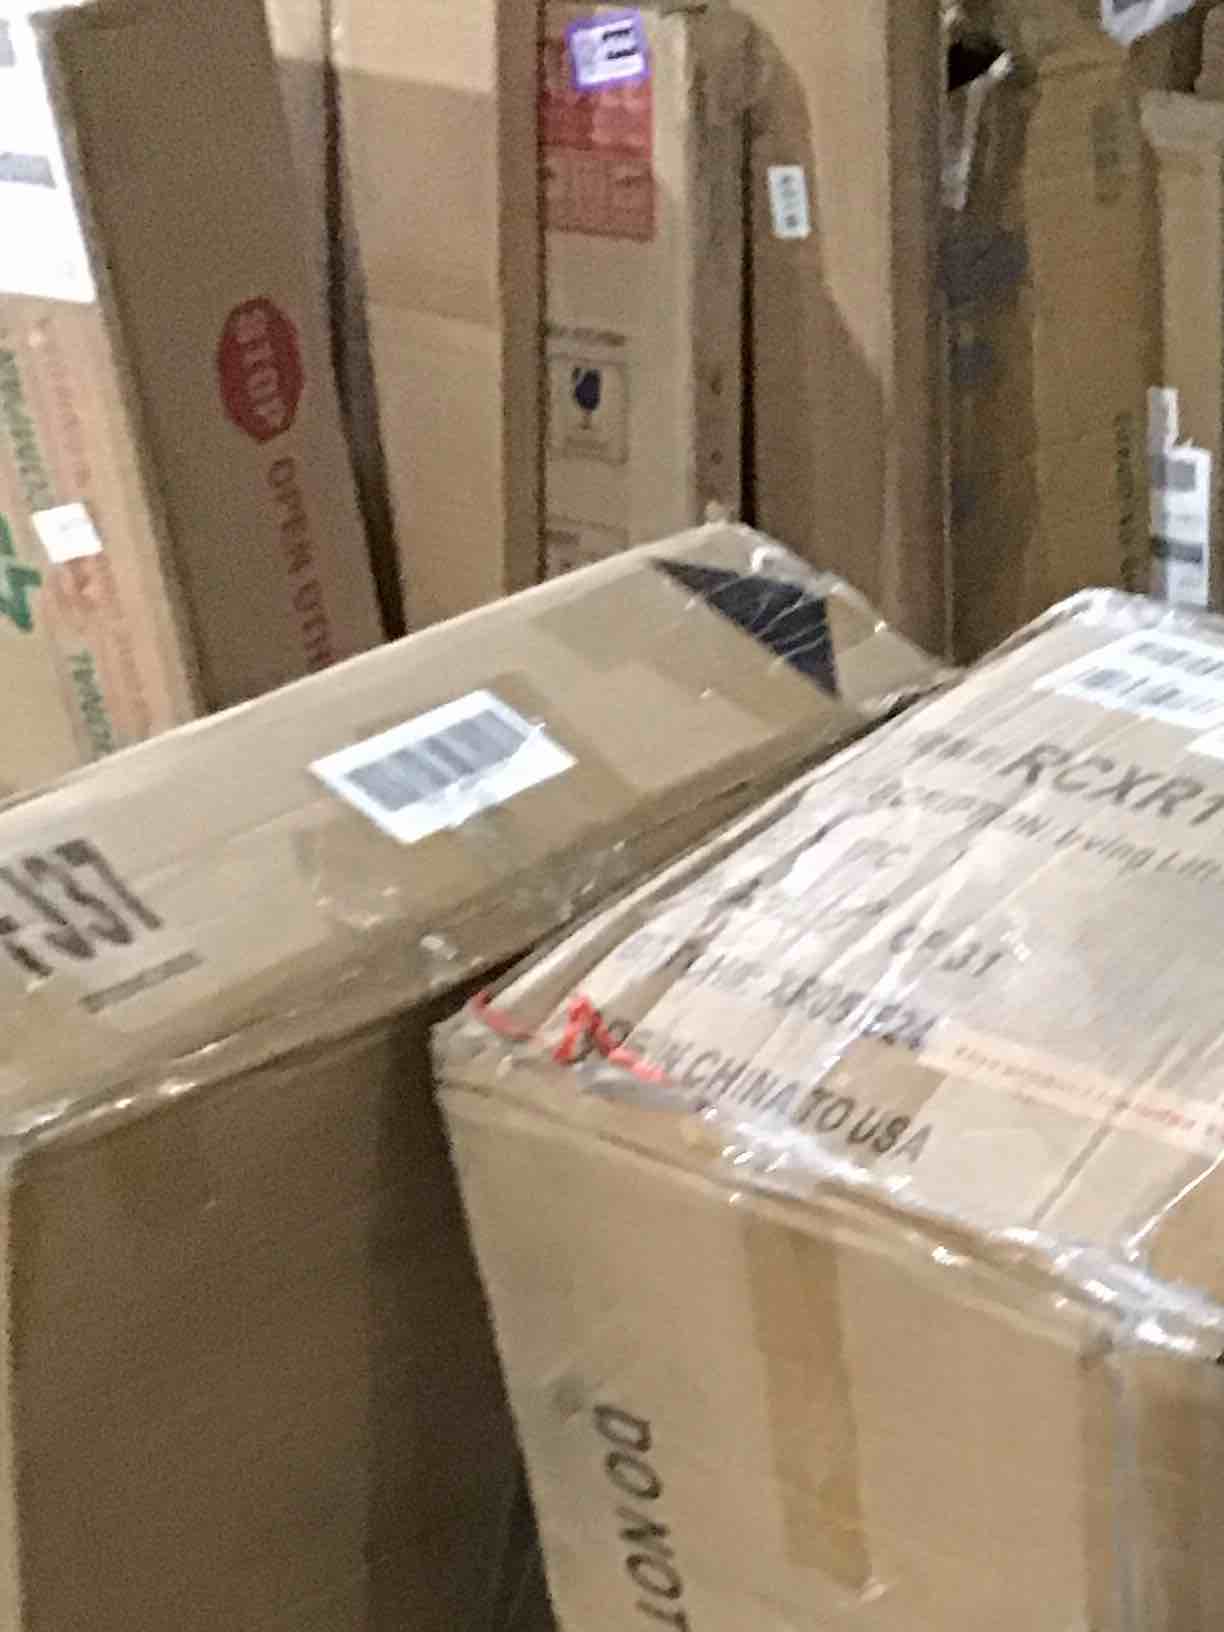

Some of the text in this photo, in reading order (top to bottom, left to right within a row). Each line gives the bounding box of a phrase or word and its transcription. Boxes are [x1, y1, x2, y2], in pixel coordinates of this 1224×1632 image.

[682, 1048, 799, 1116] CHINA
[790, 1087, 854, 1133] TO
[846, 1107, 933, 1163] USA
[592, 1404, 662, 1500] DO
